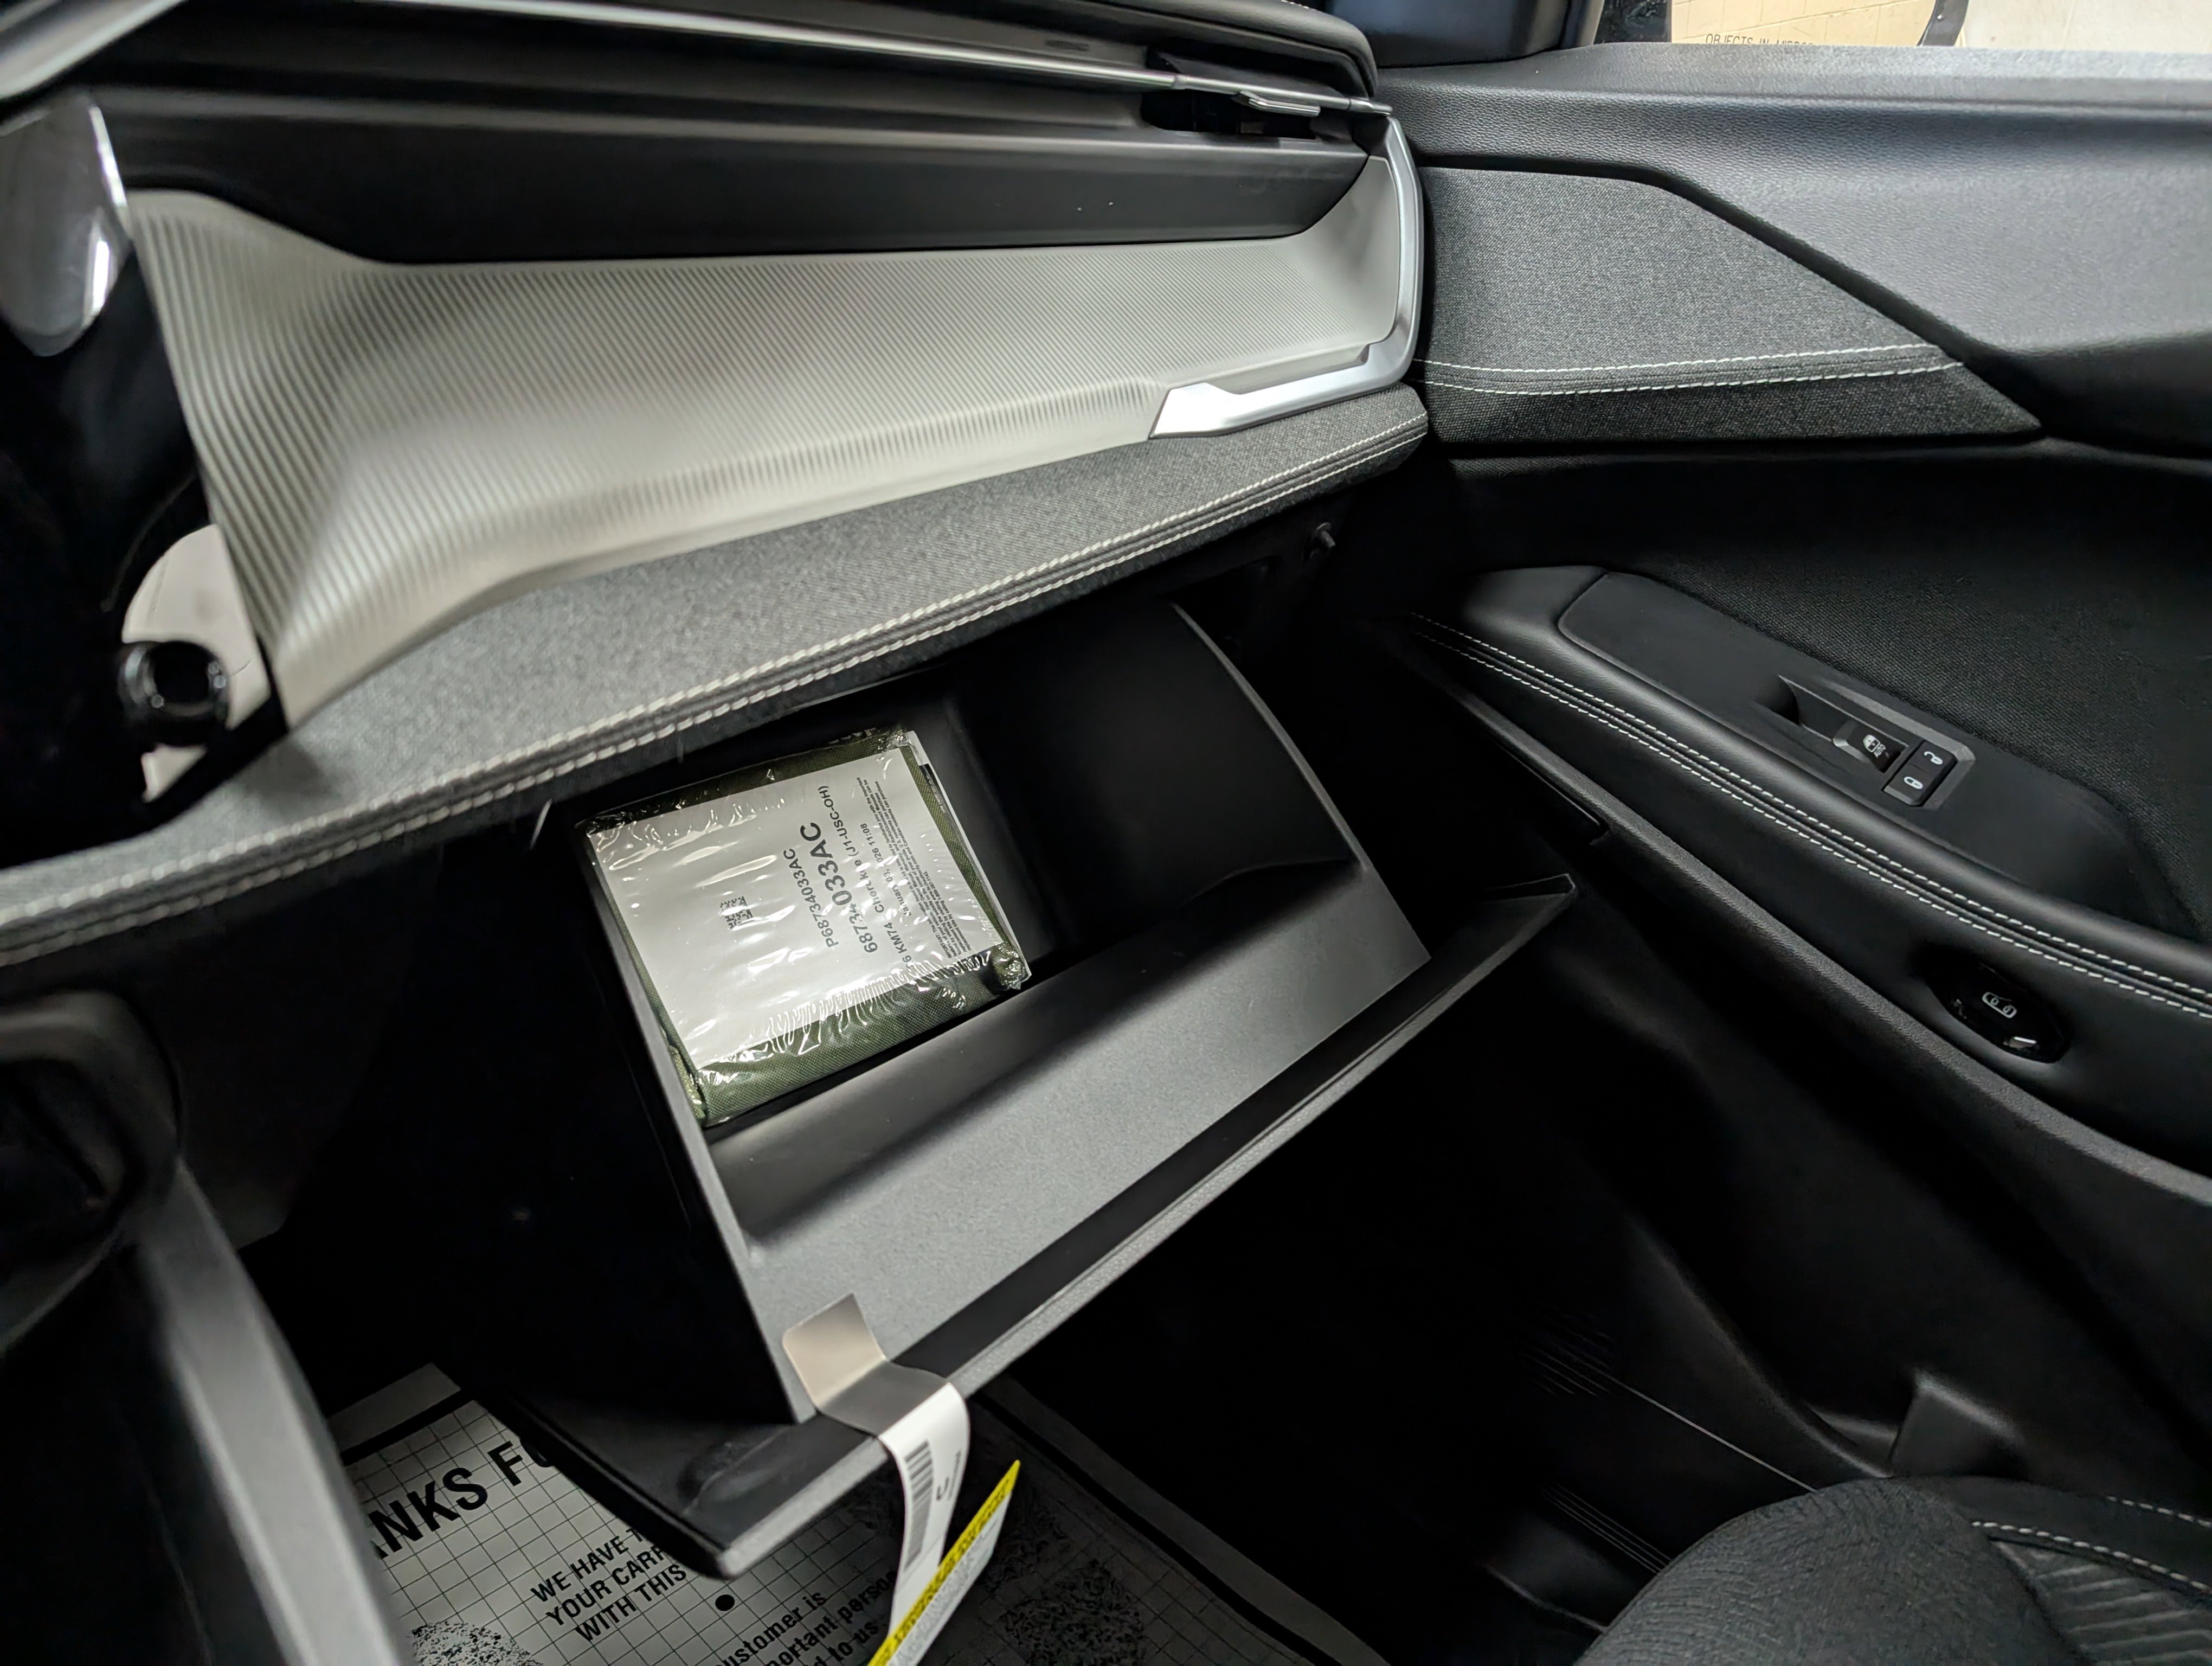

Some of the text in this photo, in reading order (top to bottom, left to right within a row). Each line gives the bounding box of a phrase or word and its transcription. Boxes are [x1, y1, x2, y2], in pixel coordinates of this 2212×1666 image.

[1706, 34, 1753, 44] OBJECTS
[1874, 744, 1886, 758] AUTO
[818, 785, 859, 857] (J1-USC-OH)
[860, 823, 874, 845] 11:08
[871, 847, 885, 868] 026
[890, 848, 901, 867] inteded
[783, 848, 839, 948] P68734033AC
[800, 822, 878, 953] 68734033AC
[854, 859, 884, 913] Cherke
[918, 902, 932, 925] infrmation
[884, 922, 906, 953] KM74
[530, 1571, 571, 1602] WE
[570, 1535, 629, 1579] HAVE
[545, 1579, 612, 1625] YOUR
[575, 1564, 687, 1642] WITH THIS
[716, 1592, 827, 1666] ustomer is
[827, 1641, 853, 1662] to
